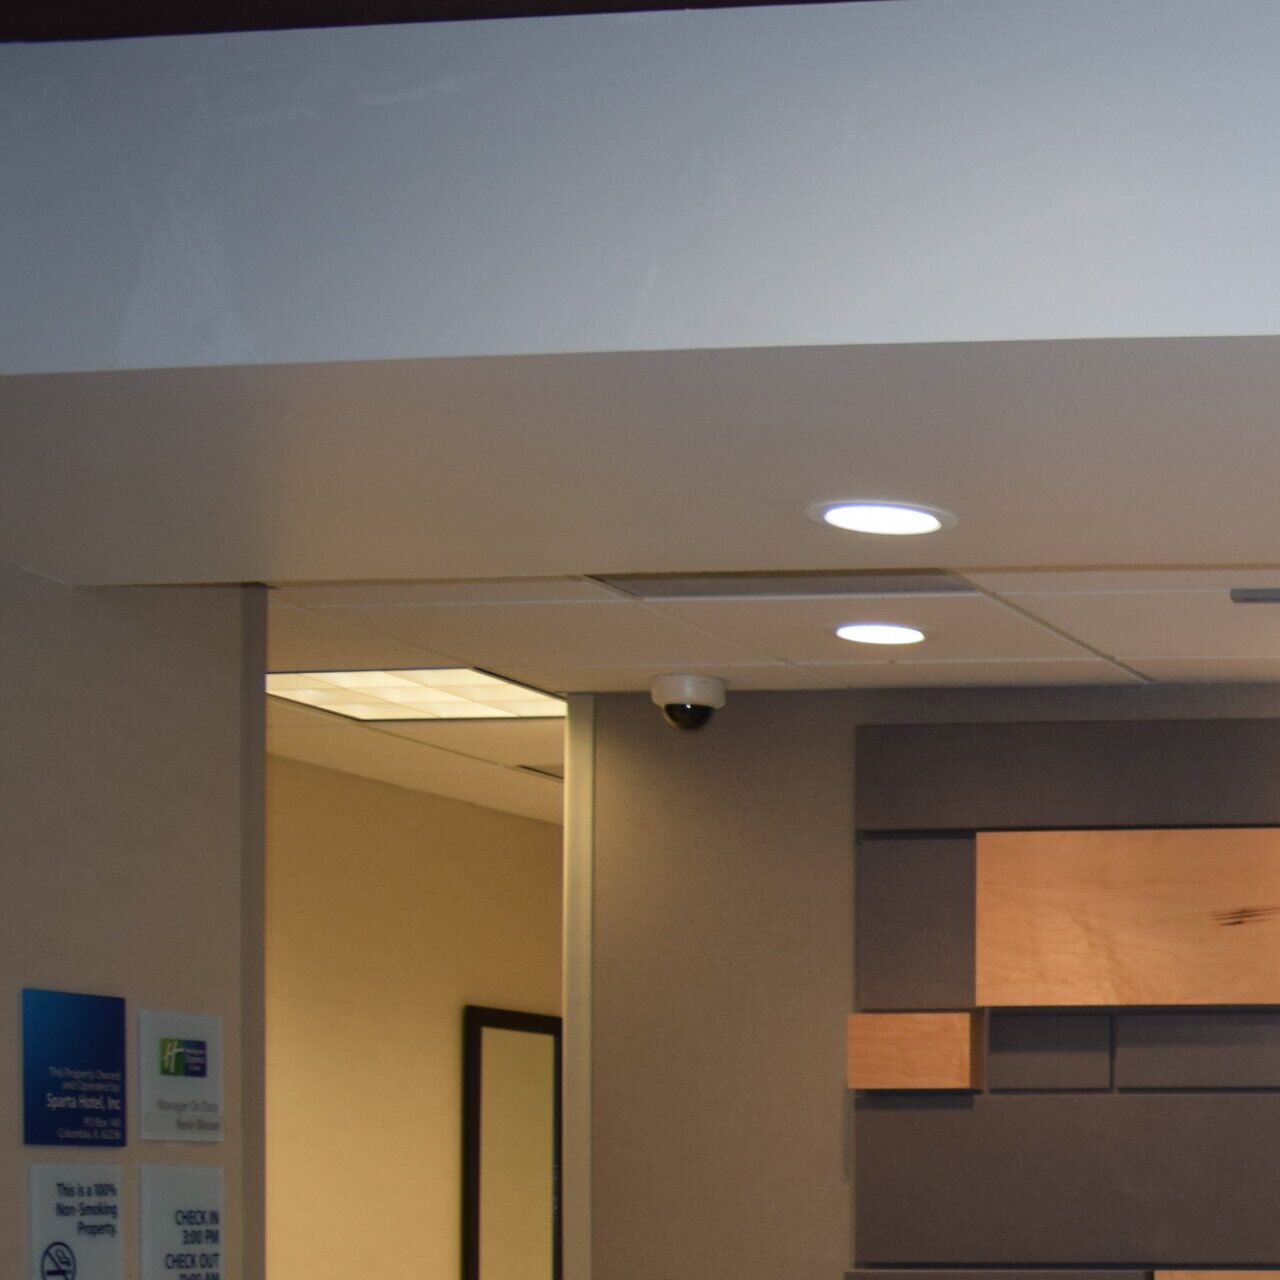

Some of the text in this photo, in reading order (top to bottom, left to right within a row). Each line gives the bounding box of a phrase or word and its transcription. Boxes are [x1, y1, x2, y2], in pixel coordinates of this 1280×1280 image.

[46, 1093, 77, 1111] Sparta
[79, 1095, 106, 1111] Hotel,
[57, 1182, 117, 1197] This is a 100%
[56, 1202, 118, 1219] Non-Smoking
[175, 1209, 220, 1225] CHECK IN
[182, 1229, 220, 1245] 3:00 PM
[164, 1252, 220, 1269] CHECK OUT
